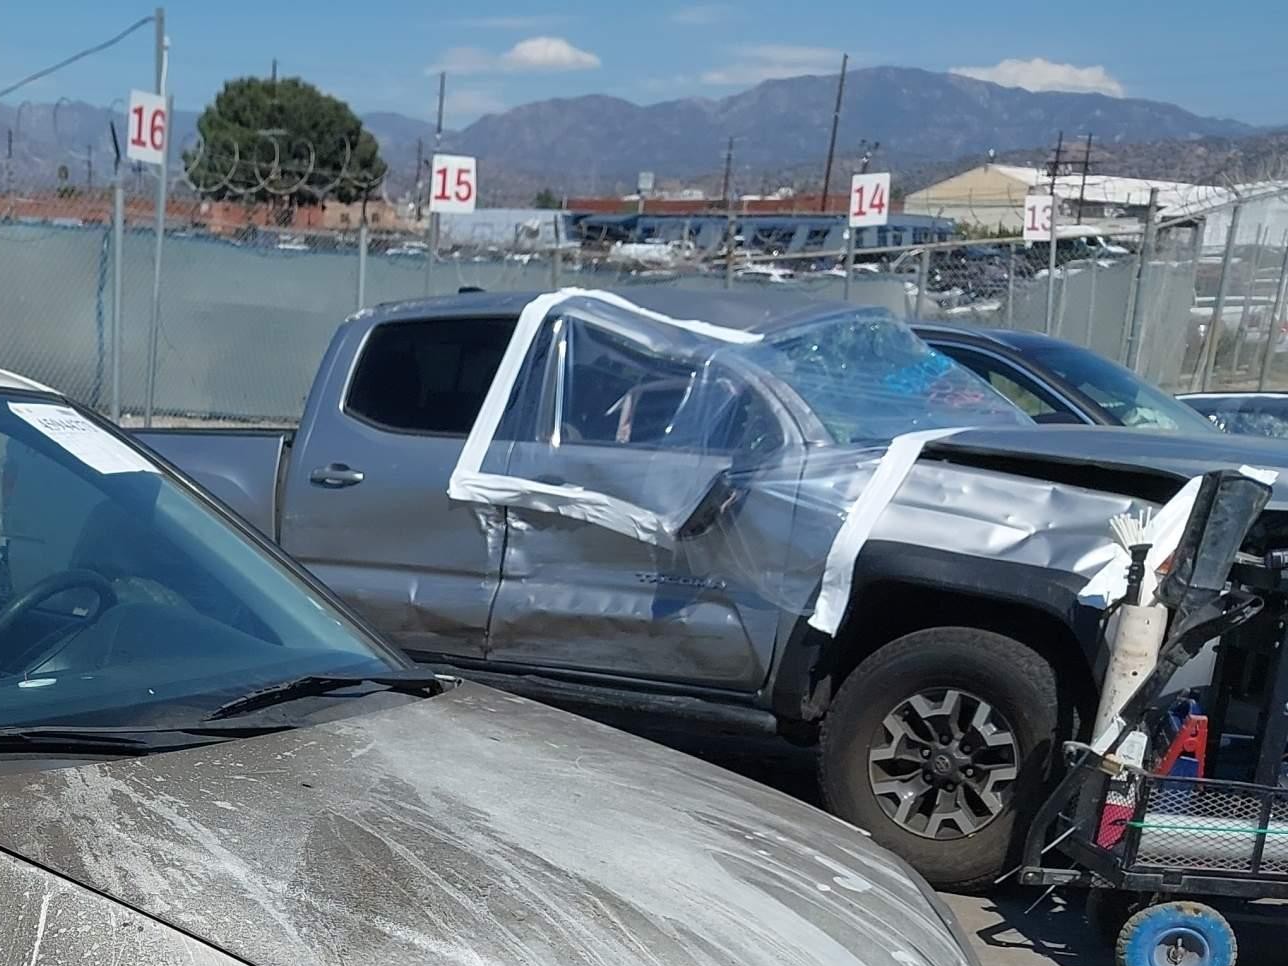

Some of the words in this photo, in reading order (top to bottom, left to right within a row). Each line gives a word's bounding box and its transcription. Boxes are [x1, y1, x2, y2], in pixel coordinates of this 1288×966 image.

[130, 105, 167, 151] 16
[433, 167, 473, 203] 15
[852, 182, 886, 217] 14
[1026, 204, 1053, 233] 13
